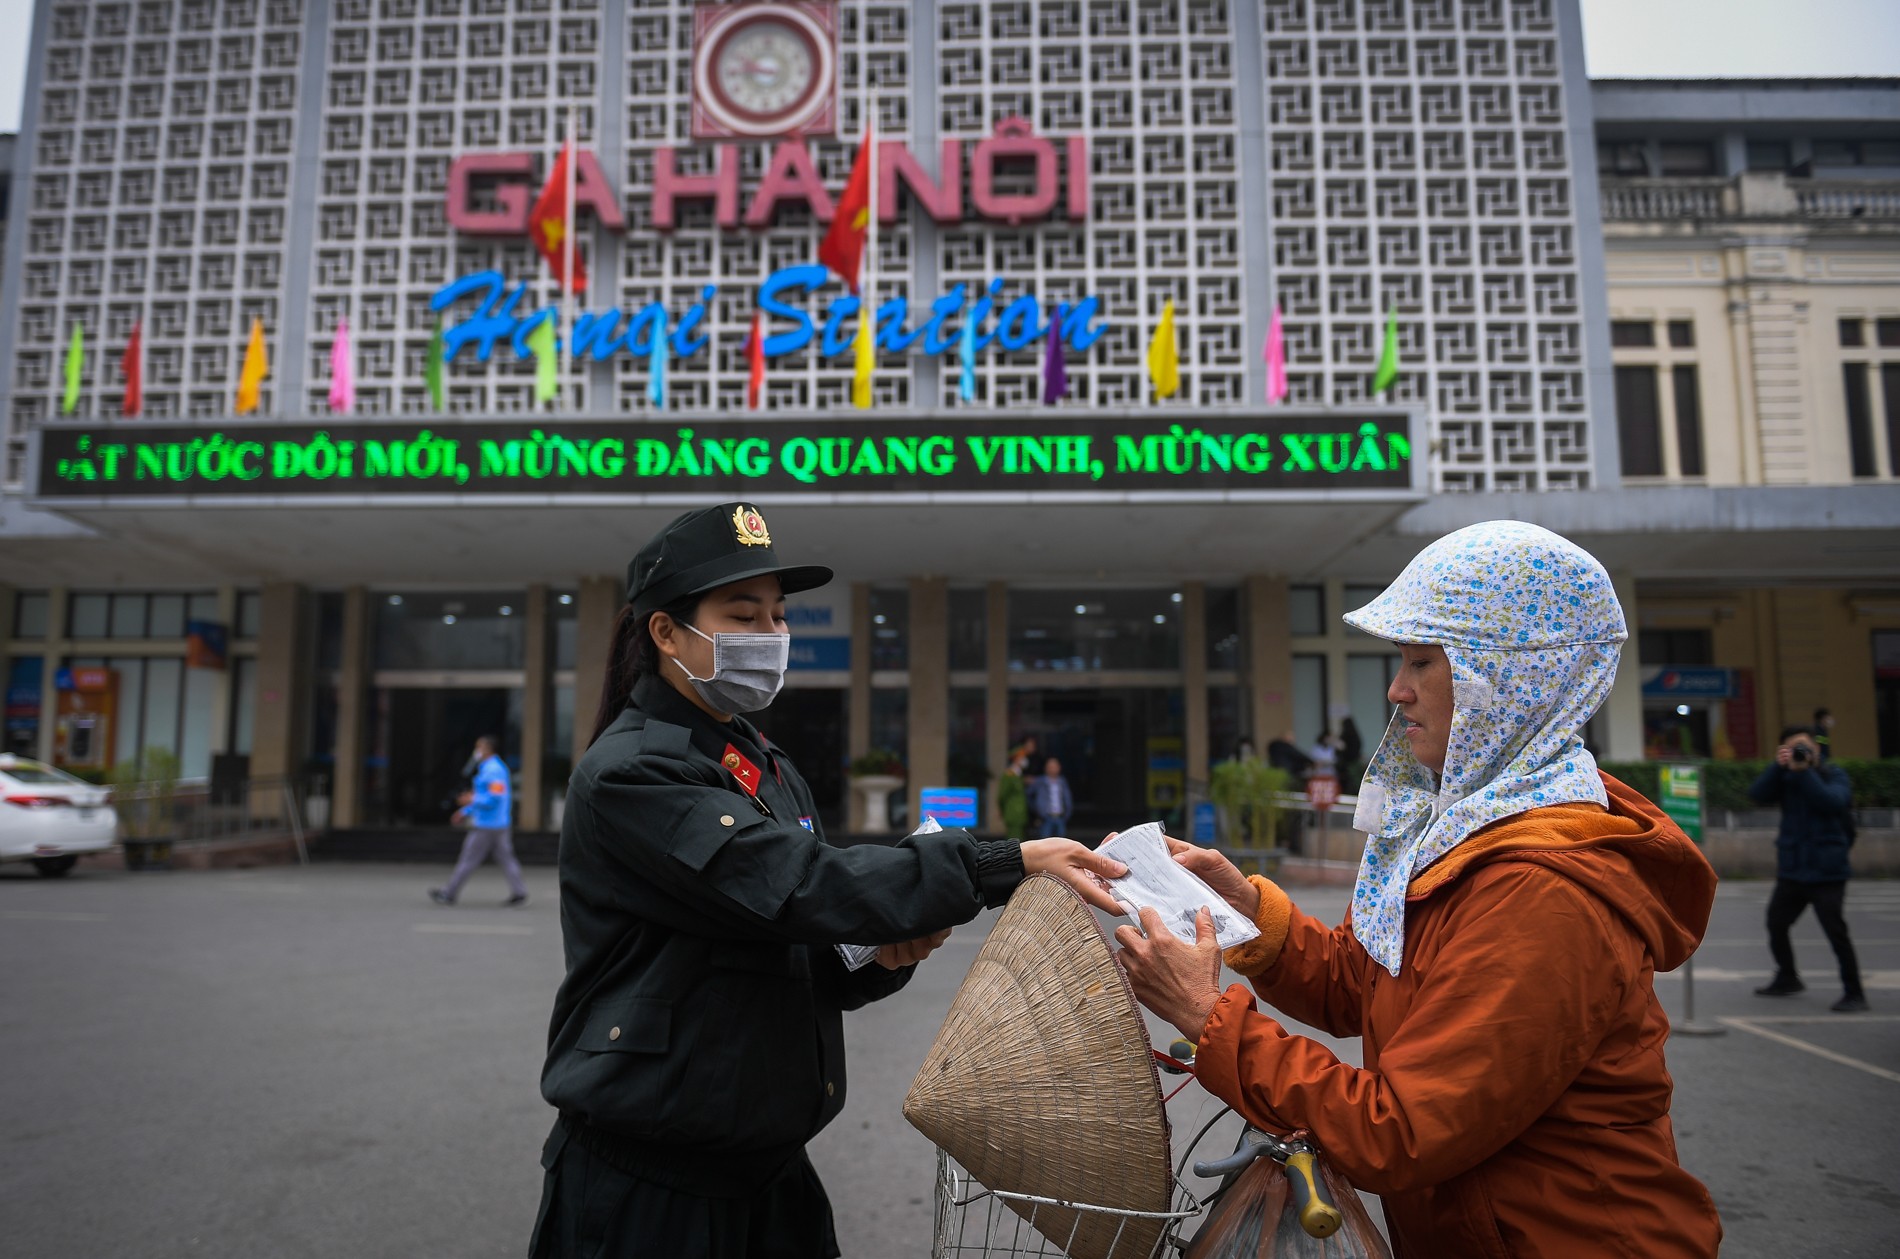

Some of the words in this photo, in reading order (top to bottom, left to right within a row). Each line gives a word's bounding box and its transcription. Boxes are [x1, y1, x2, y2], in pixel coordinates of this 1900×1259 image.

[877, 114, 1087, 226] NỘI
[429, 270, 717, 361] Hanoi
[134, 432, 267, 482] NƯỚC
[478, 429, 628, 479] MỪNG
[633, 428, 773, 478] ĐẢNG
[779, 435, 958, 484] QUANG
[964, 435, 1105, 481] VINH,
[1113, 423, 1274, 475] MỪNG
